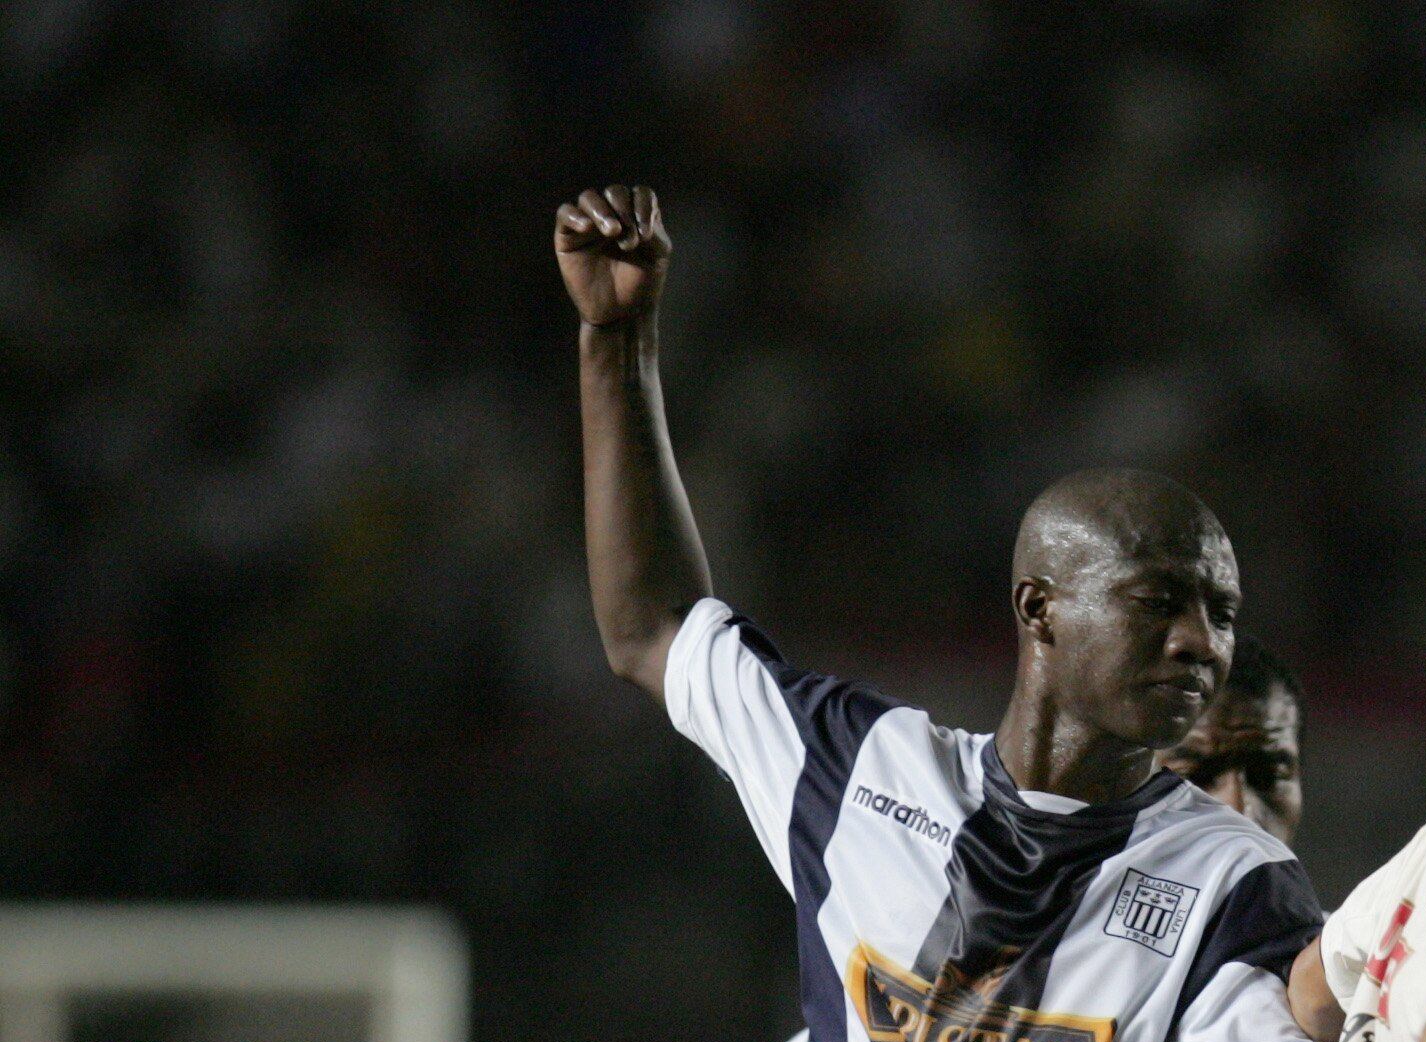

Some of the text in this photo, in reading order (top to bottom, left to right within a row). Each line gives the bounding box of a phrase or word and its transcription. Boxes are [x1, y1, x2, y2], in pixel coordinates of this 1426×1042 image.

[853, 785, 951, 846] marathon
[1139, 877, 1185, 896] ALIANZA
[1115, 890, 1132, 917] CLUB
[1170, 907, 1188, 934] LIMA
